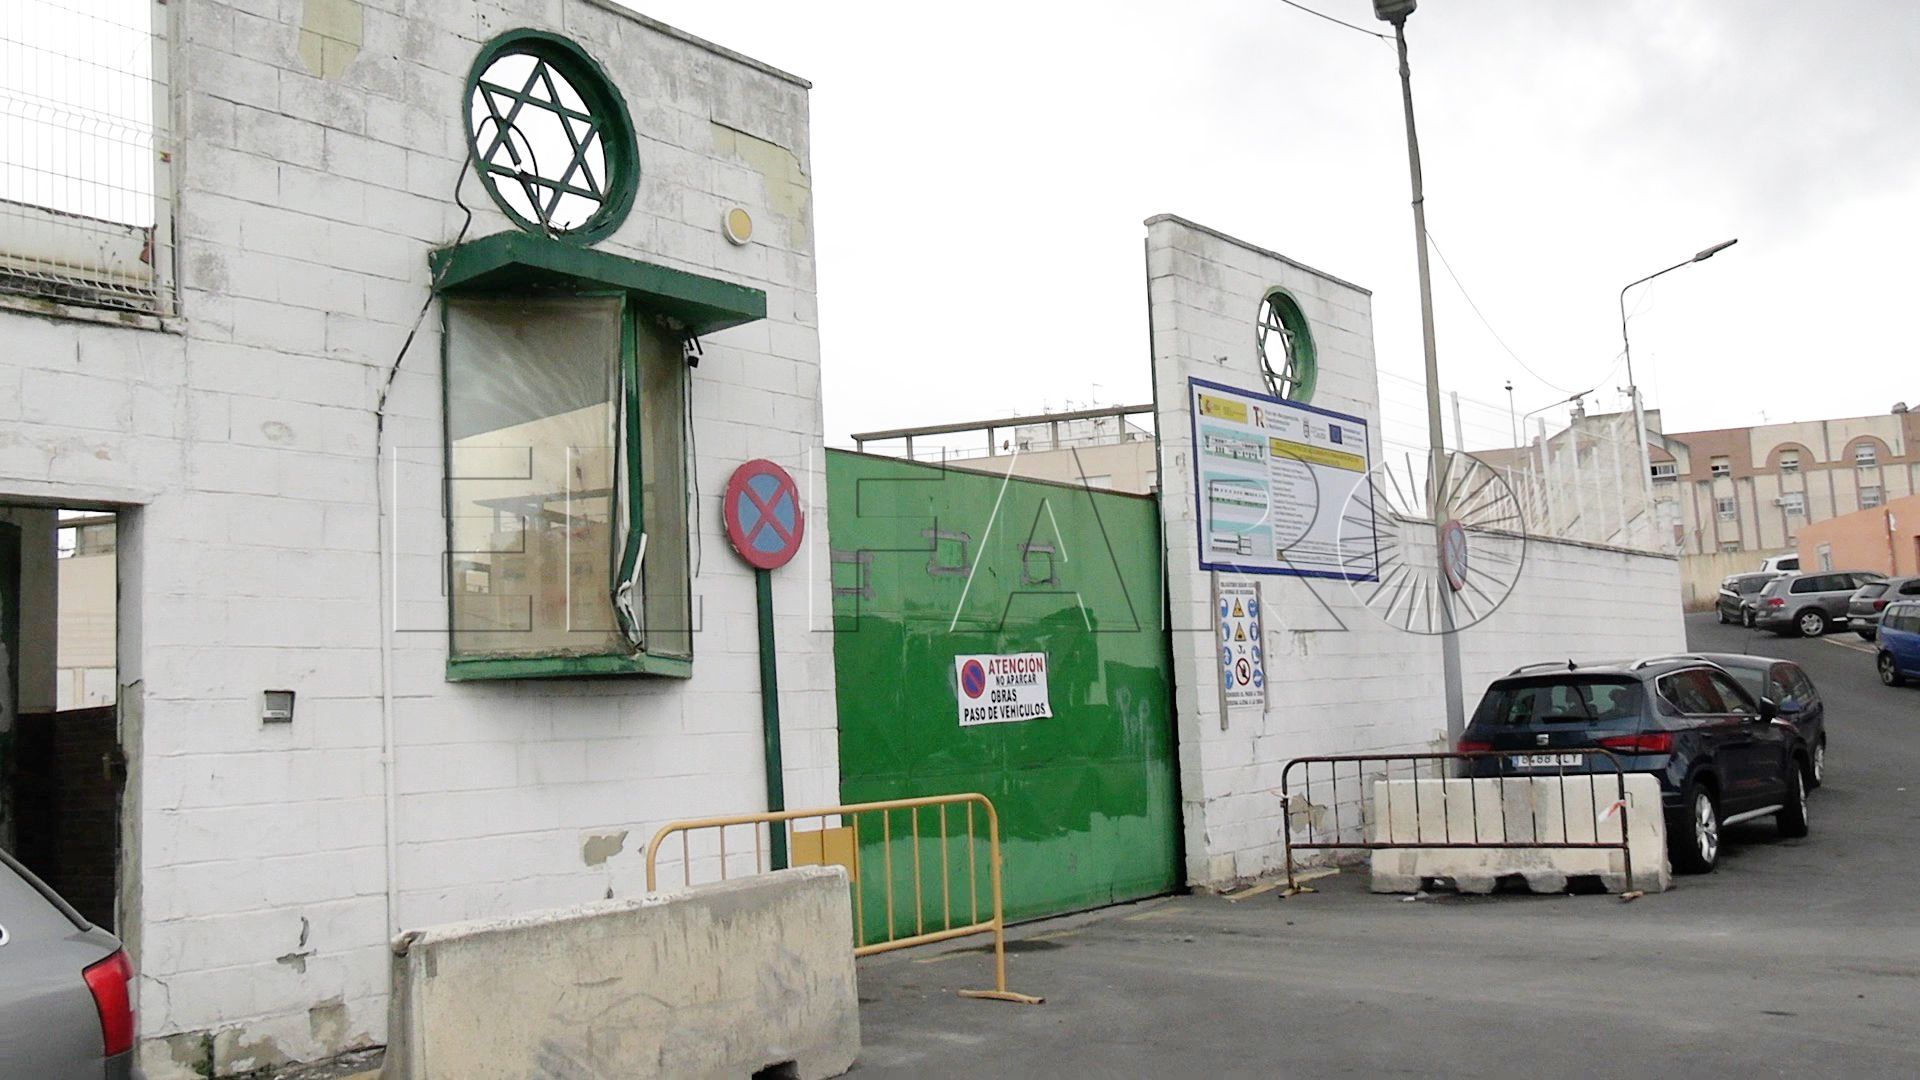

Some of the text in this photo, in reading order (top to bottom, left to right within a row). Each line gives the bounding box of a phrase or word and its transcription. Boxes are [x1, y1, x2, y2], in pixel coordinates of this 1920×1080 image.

[988, 654, 1044, 675] ATENCIÓN
[995, 673, 1037, 686] NO APARCAR
[991, 689, 1017, 703] OBRAS
[964, 706, 986, 722] PASO
[988, 706, 998, 720] DE
